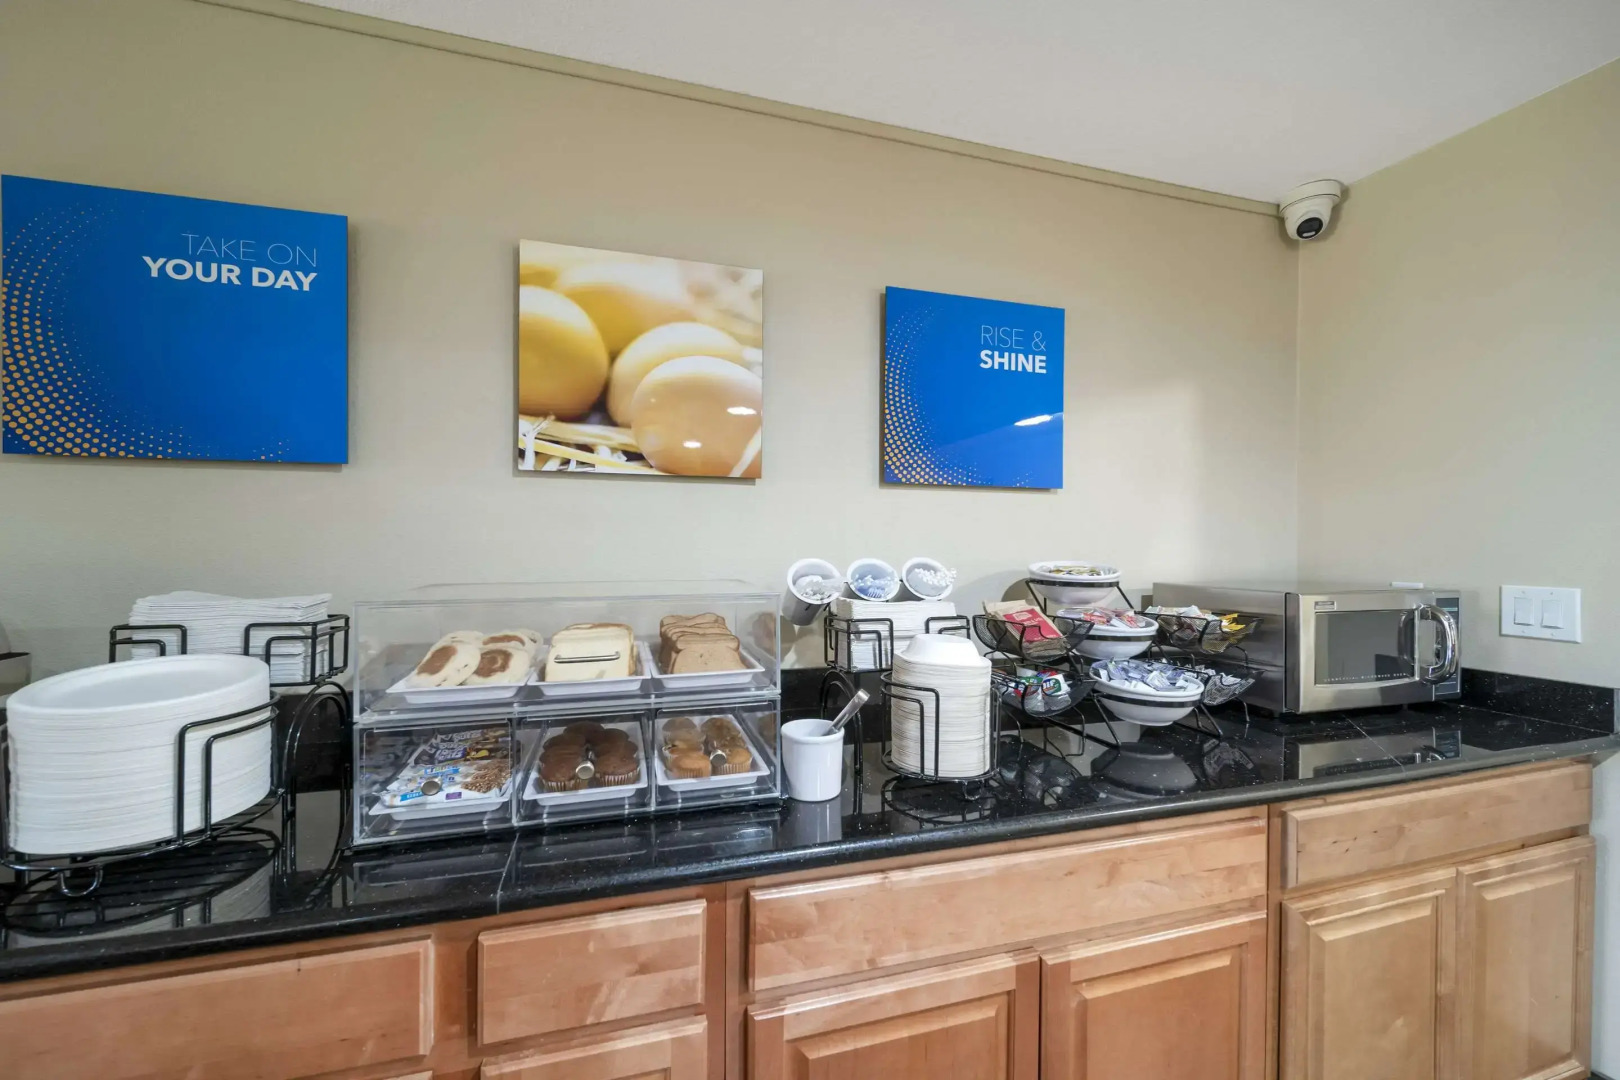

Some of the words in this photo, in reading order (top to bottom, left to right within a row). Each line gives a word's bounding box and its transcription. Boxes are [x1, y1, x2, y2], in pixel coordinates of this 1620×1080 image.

[181, 233, 256, 262] TAKE
[267, 243, 317, 267] ON
[142, 256, 241, 285] YOUR
[251, 267, 317, 291] DAY
[981, 325, 1024, 349] RISE
[1031, 330, 1046, 352] &
[979, 349, 1047, 374] SHINE
